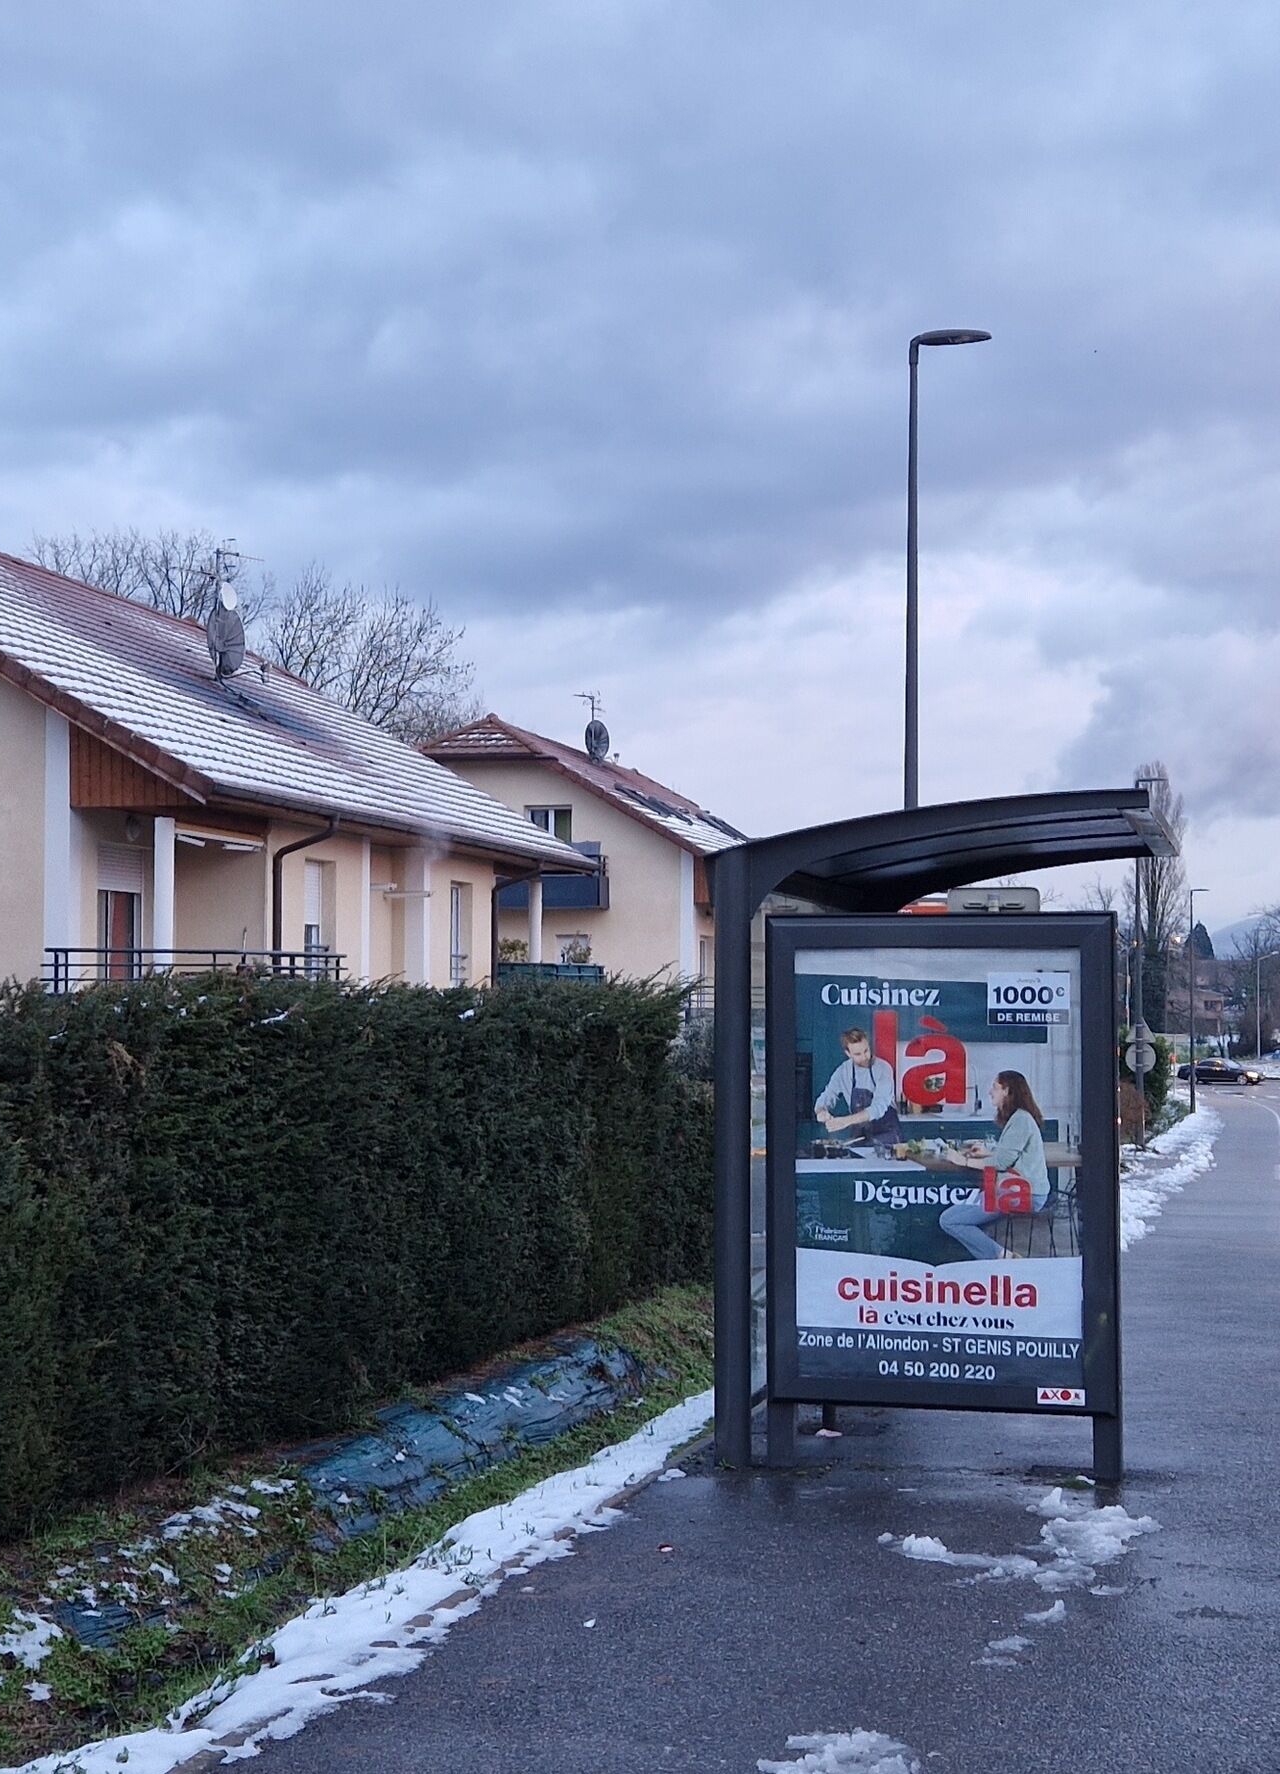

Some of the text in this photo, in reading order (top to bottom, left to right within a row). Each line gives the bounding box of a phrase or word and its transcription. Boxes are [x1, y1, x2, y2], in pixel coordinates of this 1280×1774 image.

[821, 982, 940, 1006] Cuisinez
[993, 986, 1065, 1004] 1000€
[997, 1012, 1060, 1022] DE REMISE
[873, 1009, 967, 1105] là
[854, 1166, 1032, 1213] Dégustez là
[837, 1271, 1038, 1308] cuisinella
[858, 1305, 1015, 1330] là c'est chez vous
[798, 1331, 833, 1347] Zone
[837, 1332, 854, 1348] de
[858, 1333, 930, 1351] l'Allondon
[942, 1337, 961, 1353] ST
[965, 1338, 1012, 1356] GENIS
[1016, 1341, 1080, 1359] POUILLY
[879, 1360, 996, 1380] 04 50 200 220
